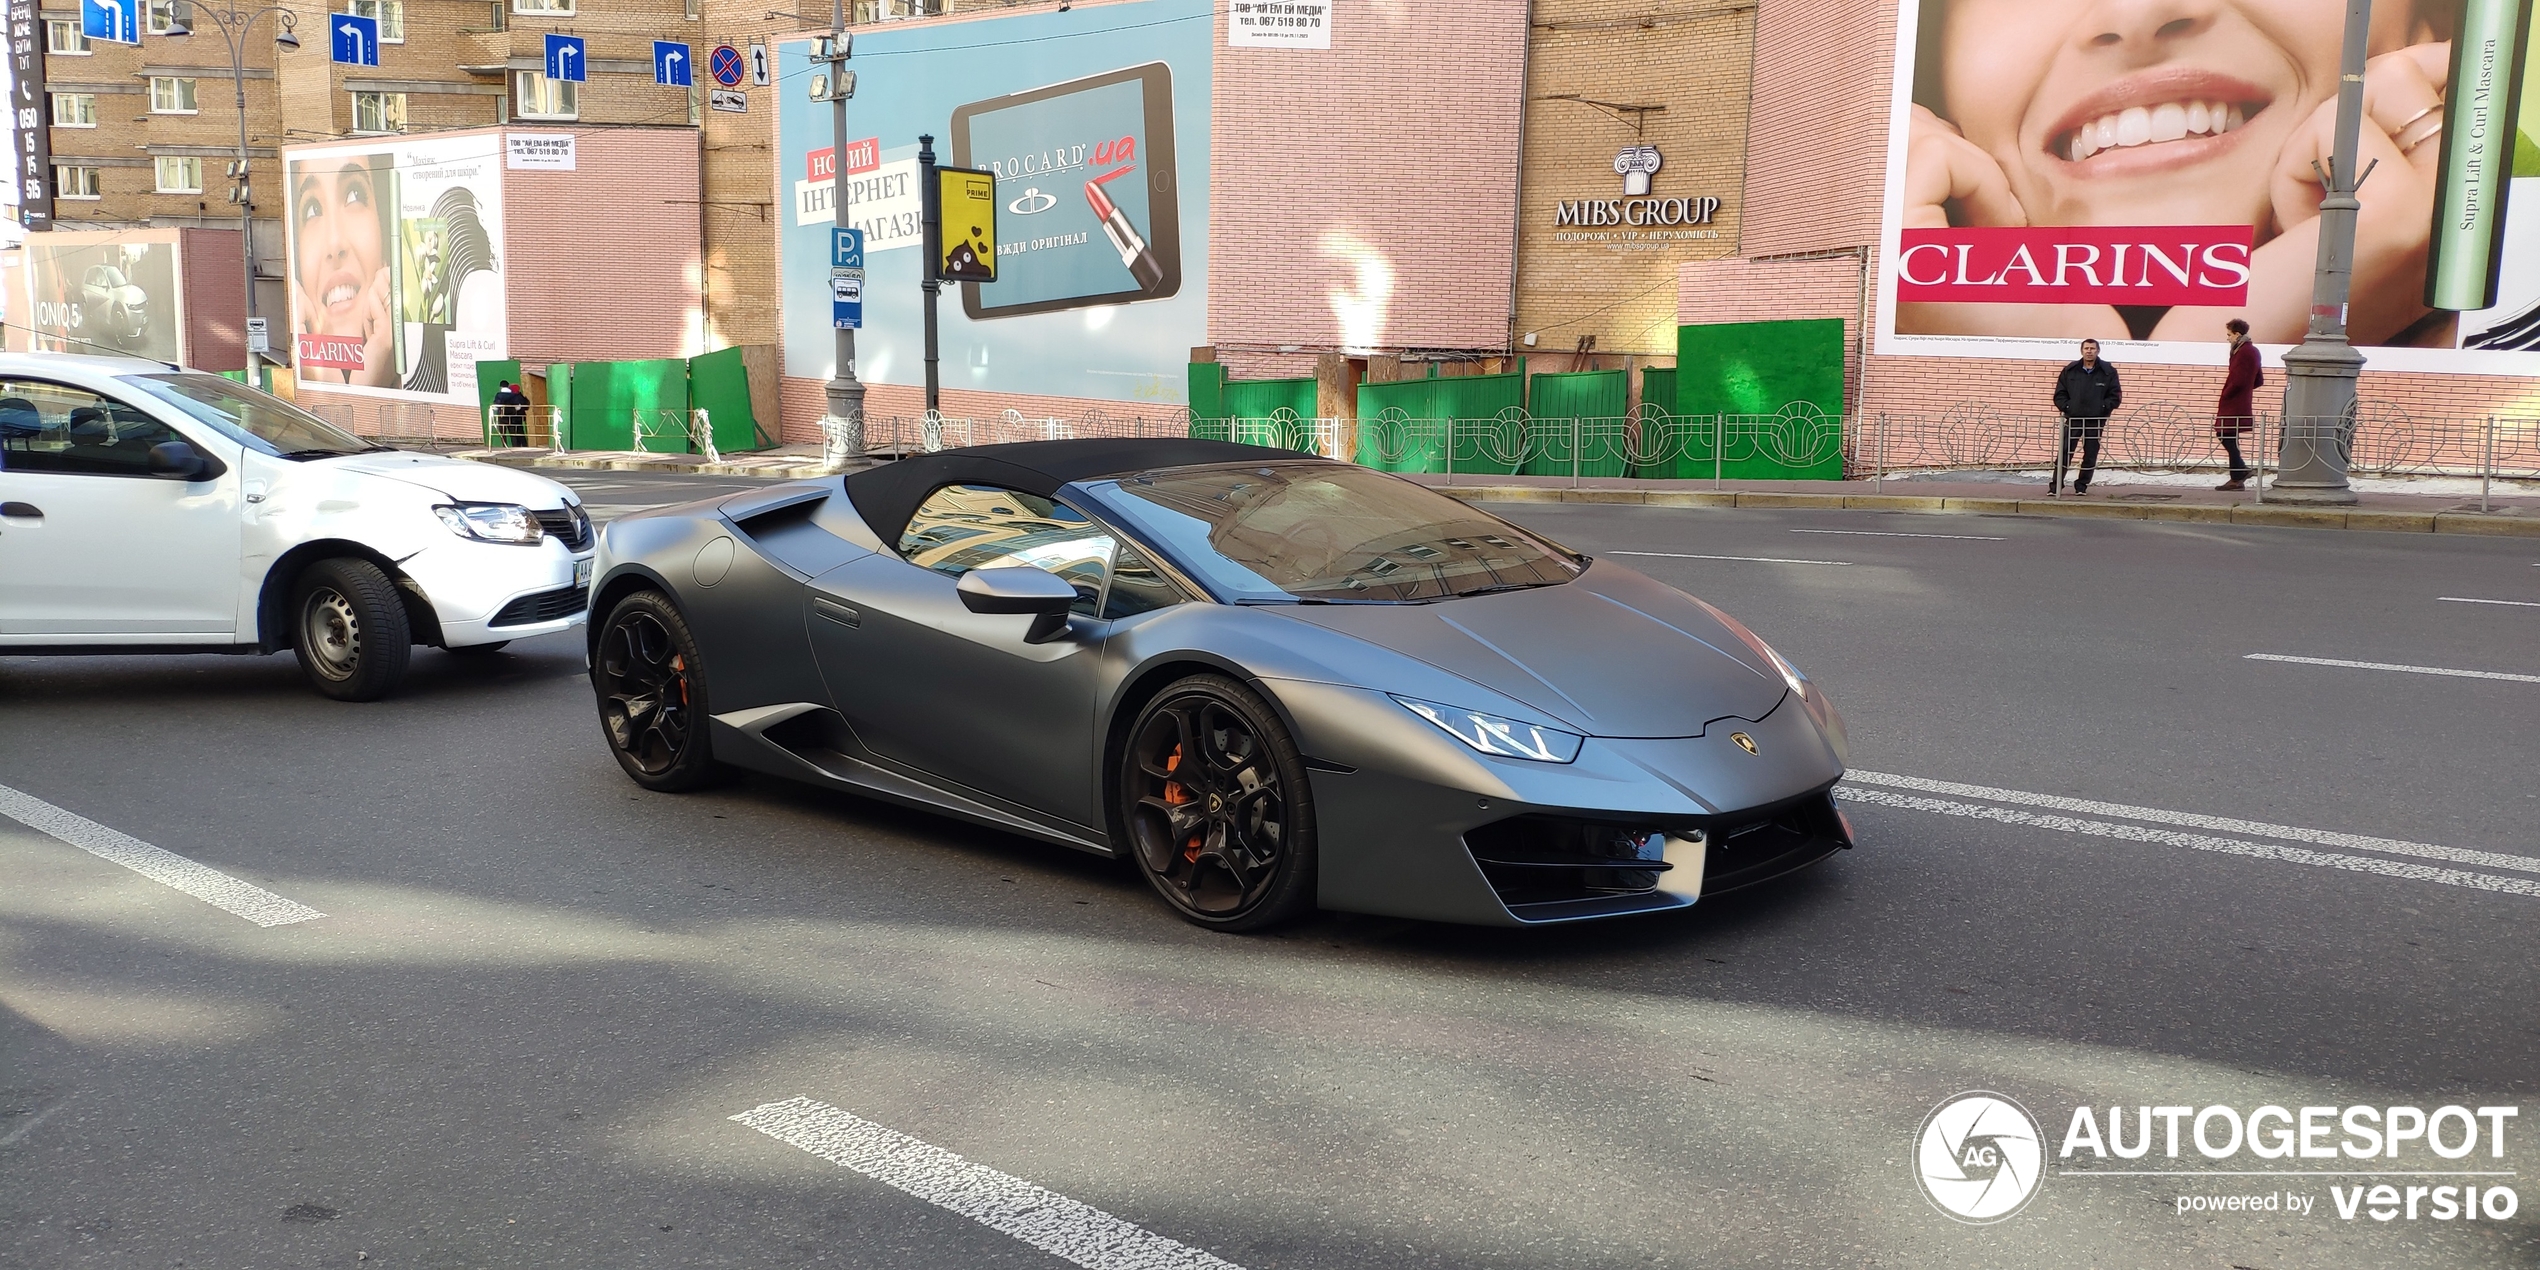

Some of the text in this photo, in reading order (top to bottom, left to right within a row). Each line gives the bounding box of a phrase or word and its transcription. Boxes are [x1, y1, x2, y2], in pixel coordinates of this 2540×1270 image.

[11, 4, 31, 21] БРЕНД
[1234, 4, 1251, 13] ТОВ
[1270, 4, 1282, 14] ЕМ
[1284, 3, 1294, 15] ЕЙ
[13, 21, 31, 38] ХОЧЕ
[1240, 16, 1321, 28] тел. 067 519 80 70
[15, 39, 31, 54] БУТИ
[18, 55, 30, 70] ТУТ
[19, 107, 37, 130] 050
[24, 131, 35, 153] 15
[510, 139, 521, 147] ТОВ
[2460, 39, 2496, 231] Supra Lift & Curl Mascara
[26, 155, 36, 175] 15
[813, 140, 874, 177] НОИЙ
[26, 179, 41, 200] 515
[967, 189, 988, 198] PRIME
[1555, 196, 1720, 226] MIBS GROUP
[1031, 232, 1088, 251] ОРИГІНАЛ
[1556, 230, 1719, 241] ПОДОРОЖІ VIP НЕРУХОМІСТЬ
[1898, 243, 2250, 288] CLARINS
[36, 301, 80, 333] IONIQ 5
[299, 340, 365, 364] CLARINS
[449, 339, 496, 350] Supra Lift & Curl
[449, 350, 473, 360] Mascara
